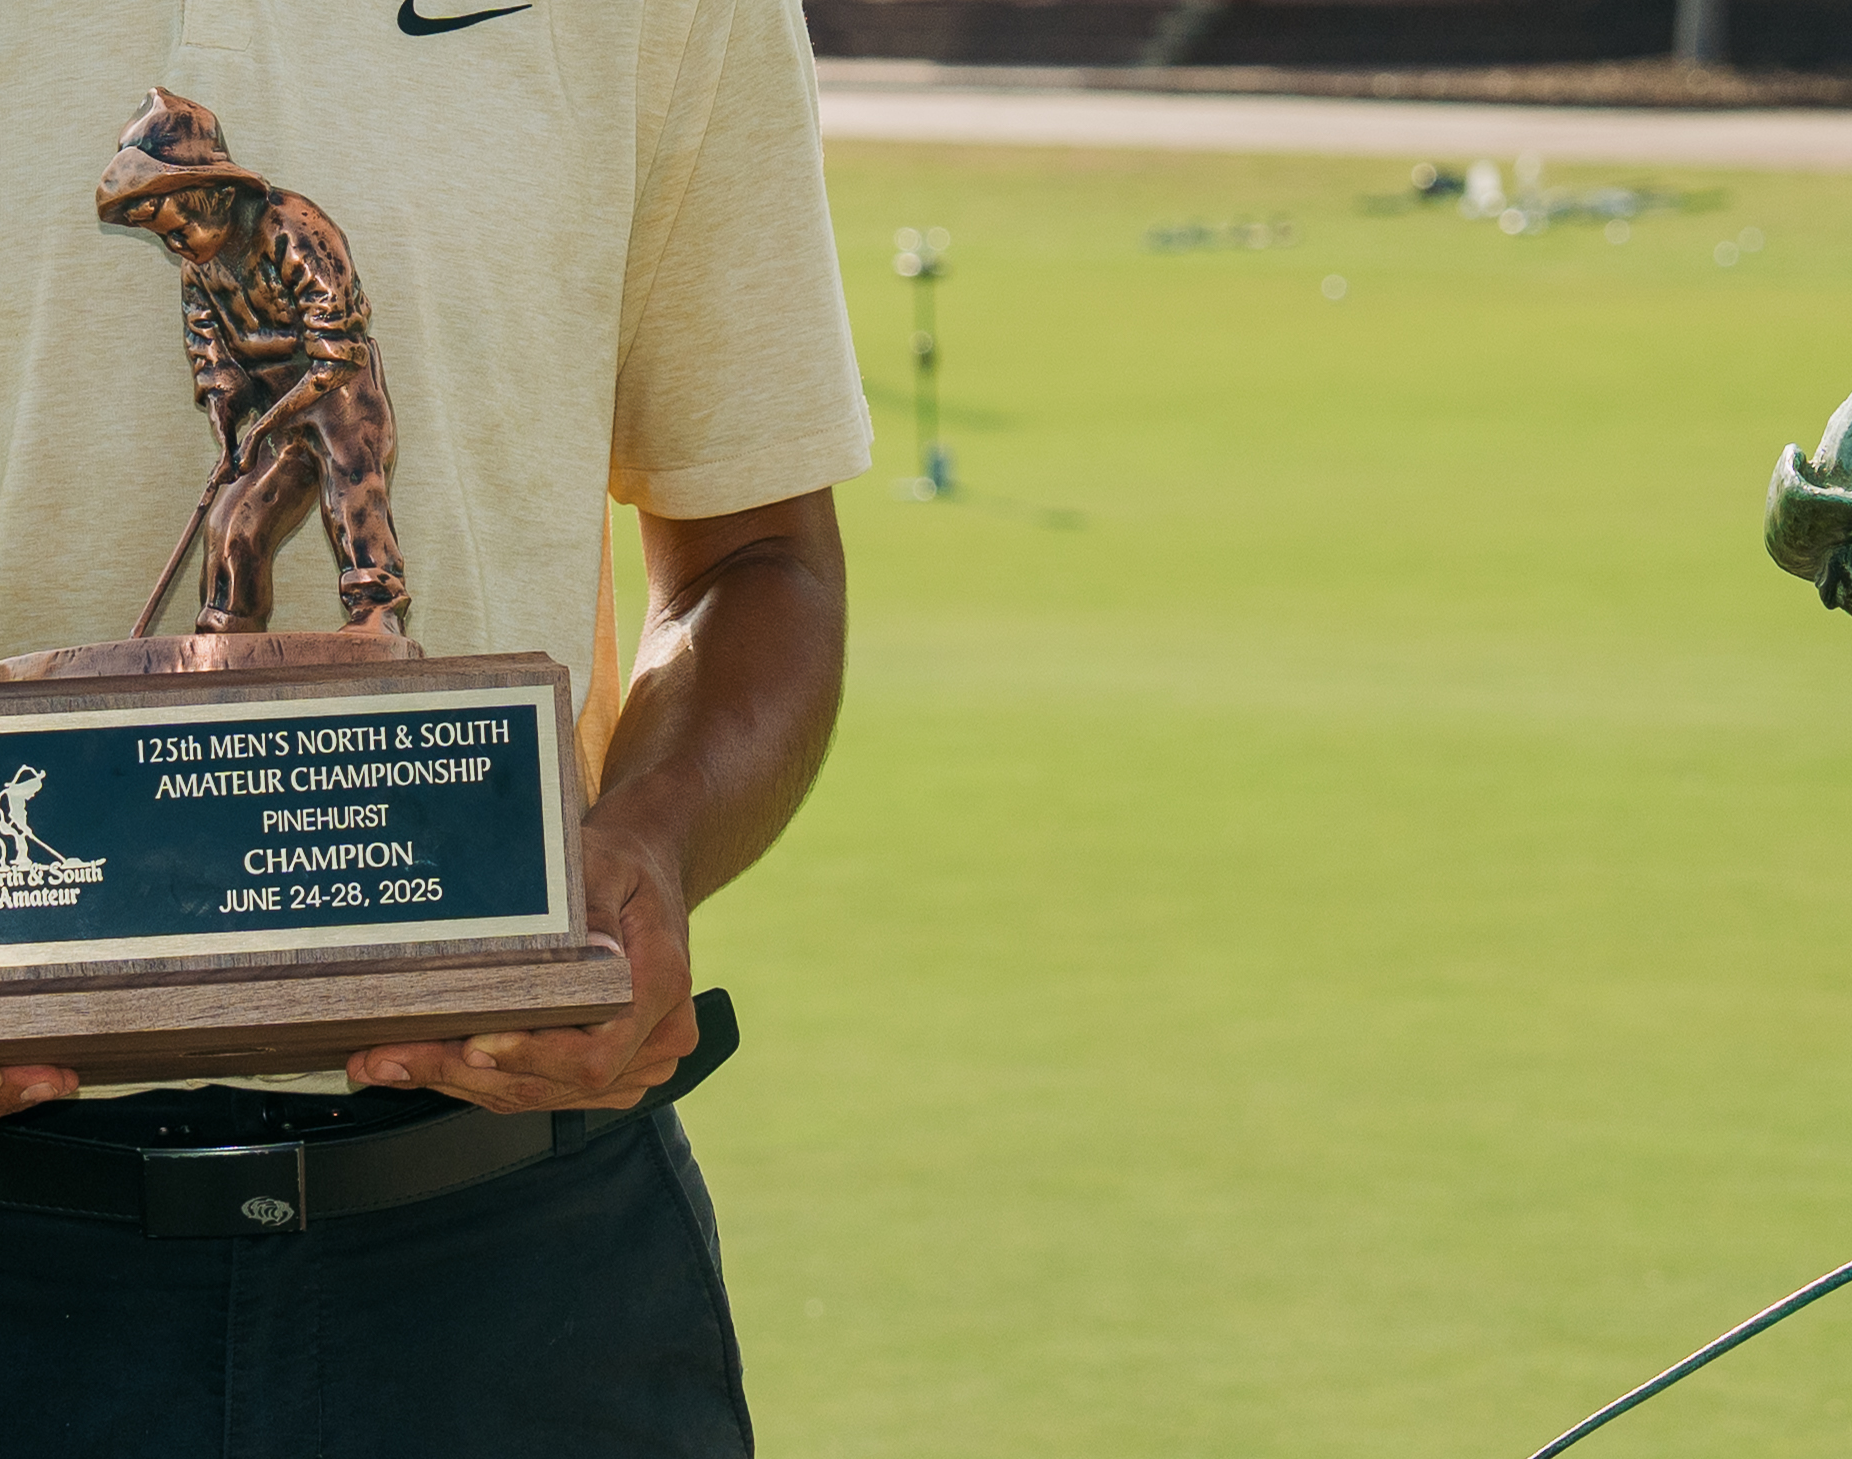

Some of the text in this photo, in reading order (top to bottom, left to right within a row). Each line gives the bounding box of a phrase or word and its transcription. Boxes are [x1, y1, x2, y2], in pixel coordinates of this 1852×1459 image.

[138, 735, 202, 763] 125th
[297, 727, 386, 754] NORTH
[395, 725, 412, 749] &
[421, 720, 509, 747] SOUTH
[155, 757, 491, 799] AMATEUR CHAMPIONSHIP
[263, 804, 389, 833] PINEHURST
[27, 862, 45, 886] &
[48, 861, 104, 885] South
[244, 841, 413, 874] CHAMPION
[219, 878, 442, 913] JUNE 24-28, 2025
